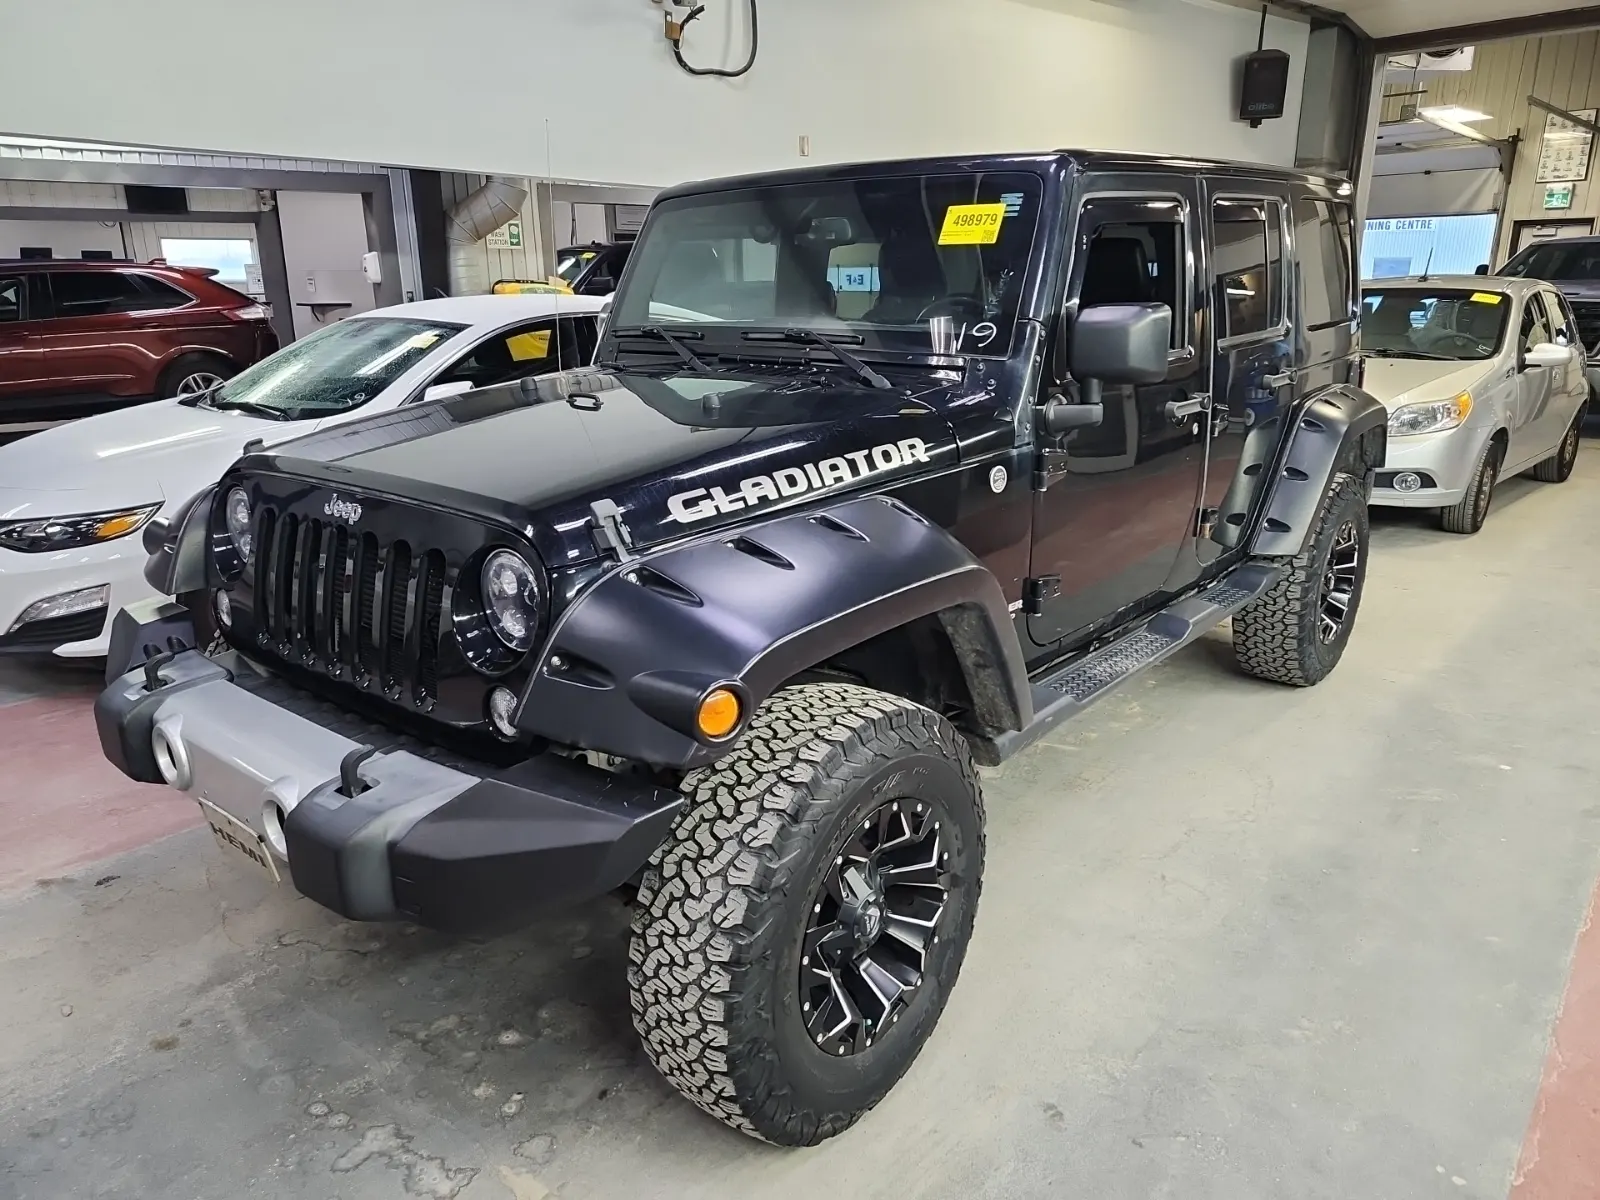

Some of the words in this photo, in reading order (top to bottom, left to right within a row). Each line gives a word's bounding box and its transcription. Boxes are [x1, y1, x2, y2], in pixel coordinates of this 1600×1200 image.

[953, 213, 998, 227] 498979
[1365, 220, 1391, 231] NING
[1395, 219, 1433, 230] CENTRE
[488, 238, 509, 246] STATION
[956, 321, 997, 351] 19
[667, 437, 931, 524] GLADIATOR
[323, 493, 362, 525] Jeep
[209, 820, 268, 869] HEMI
